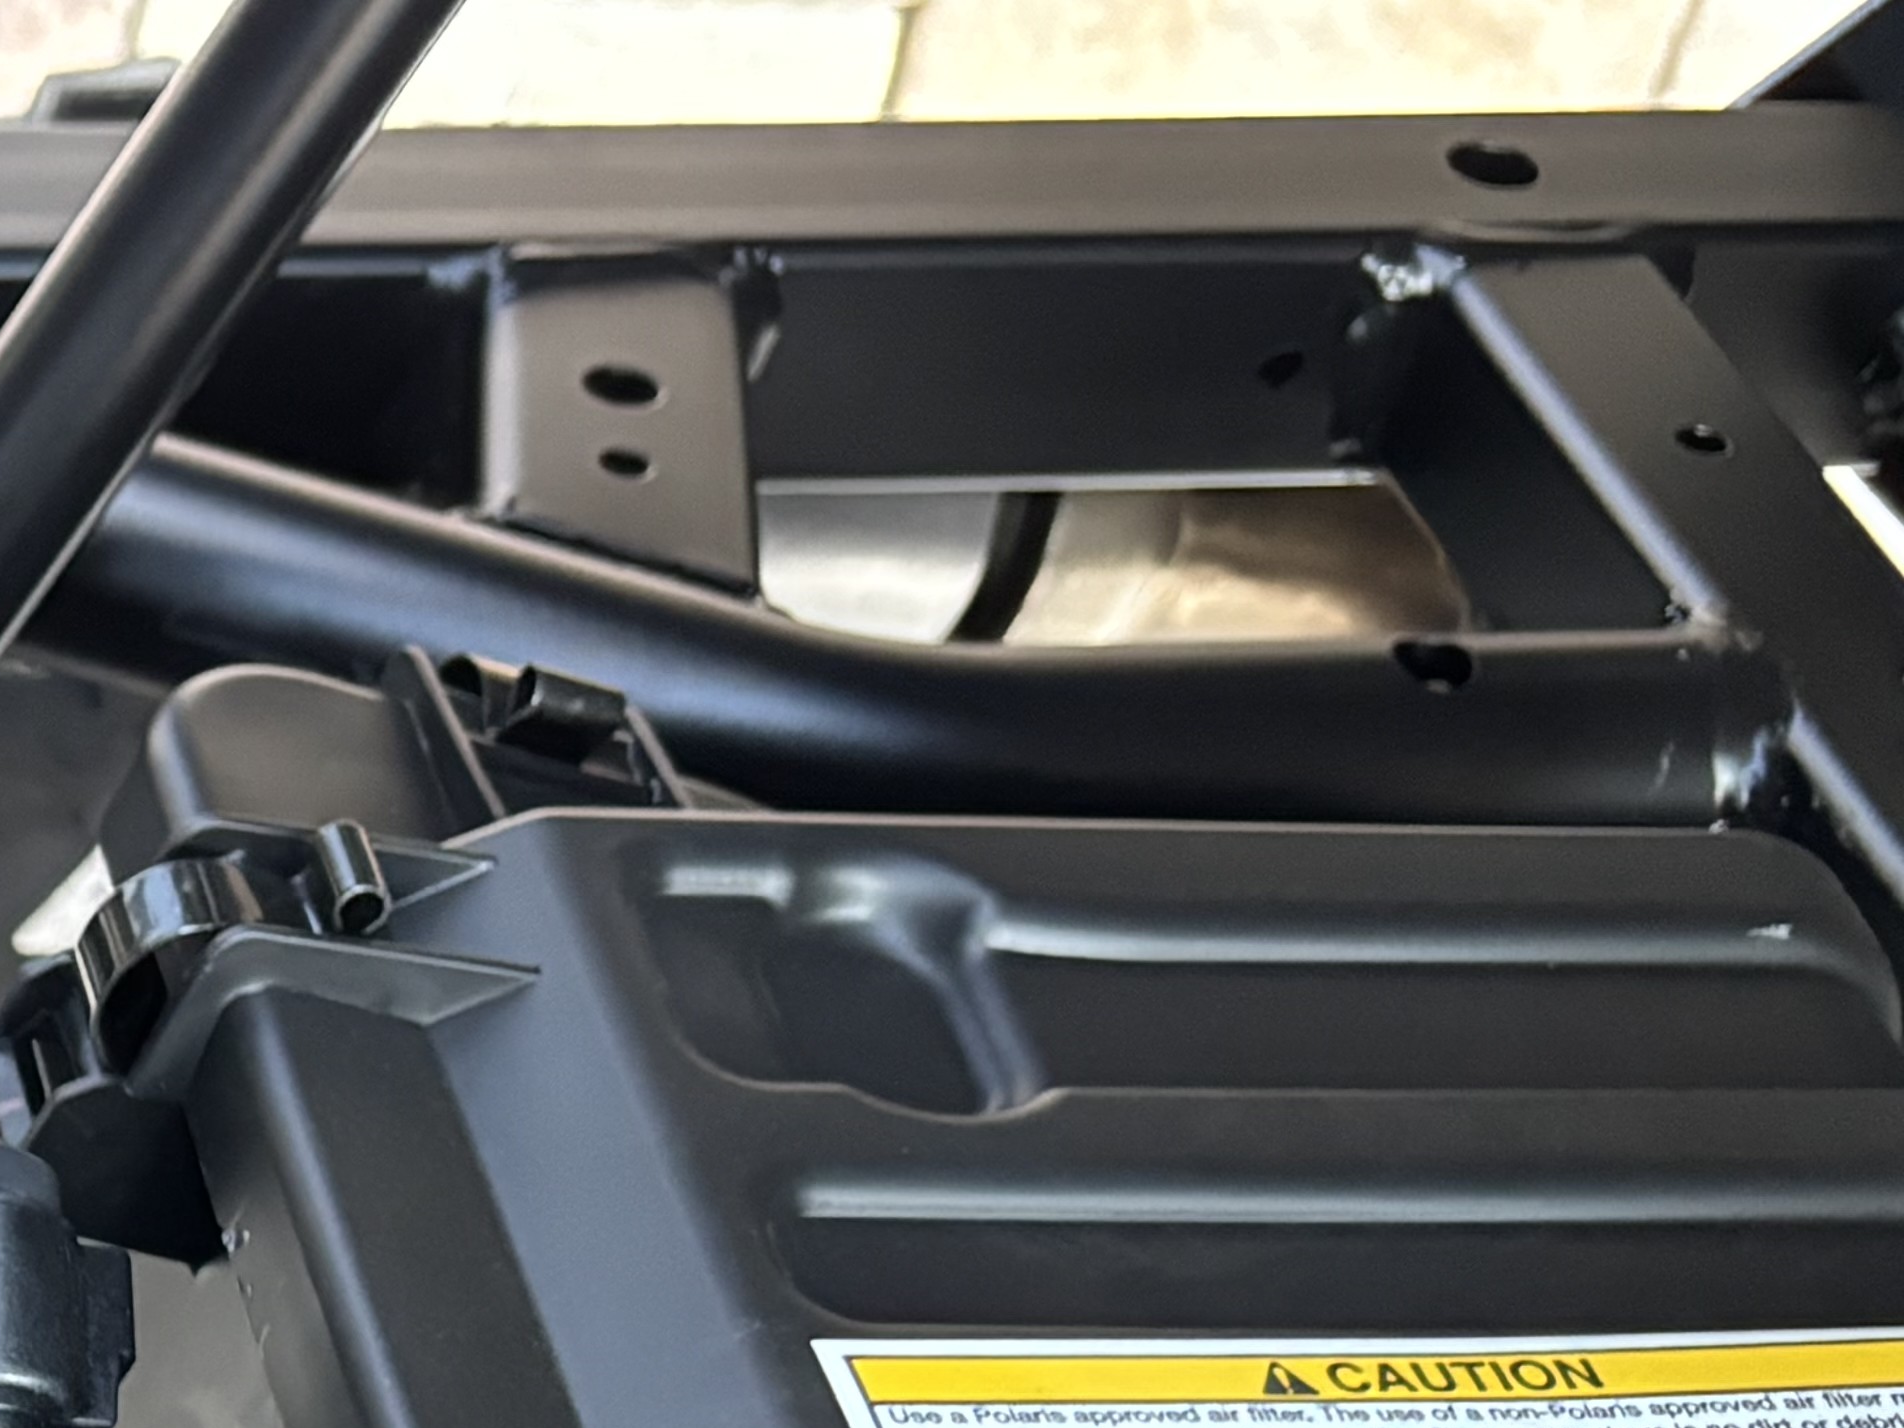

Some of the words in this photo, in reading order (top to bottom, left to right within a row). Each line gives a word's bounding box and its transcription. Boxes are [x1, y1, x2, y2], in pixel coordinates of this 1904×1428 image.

[1326, 1358, 1605, 1393] CAUTION
[888, 1406, 943, 1424] Use
[951, 1409, 968, 1424] a
[973, 1406, 1067, 1425] Polaris
[1074, 1404, 1201, 1427] approved
[1208, 1403, 1239, 1422] air
[1249, 1402, 1314, 1422] filter.
[1321, 1402, 1370, 1422] The
[1376, 1407, 1425, 1421] use
[1432, 1403, 1457, 1420] of
[1466, 1406, 1484, 1421] a
[1489, 1401, 1643, 1421] non-Polaris
[1650, 1394, 1776, 1418] approved
[1783, 1392, 1814, 1410] air
[1823, 1390, 1882, 1408] filter
